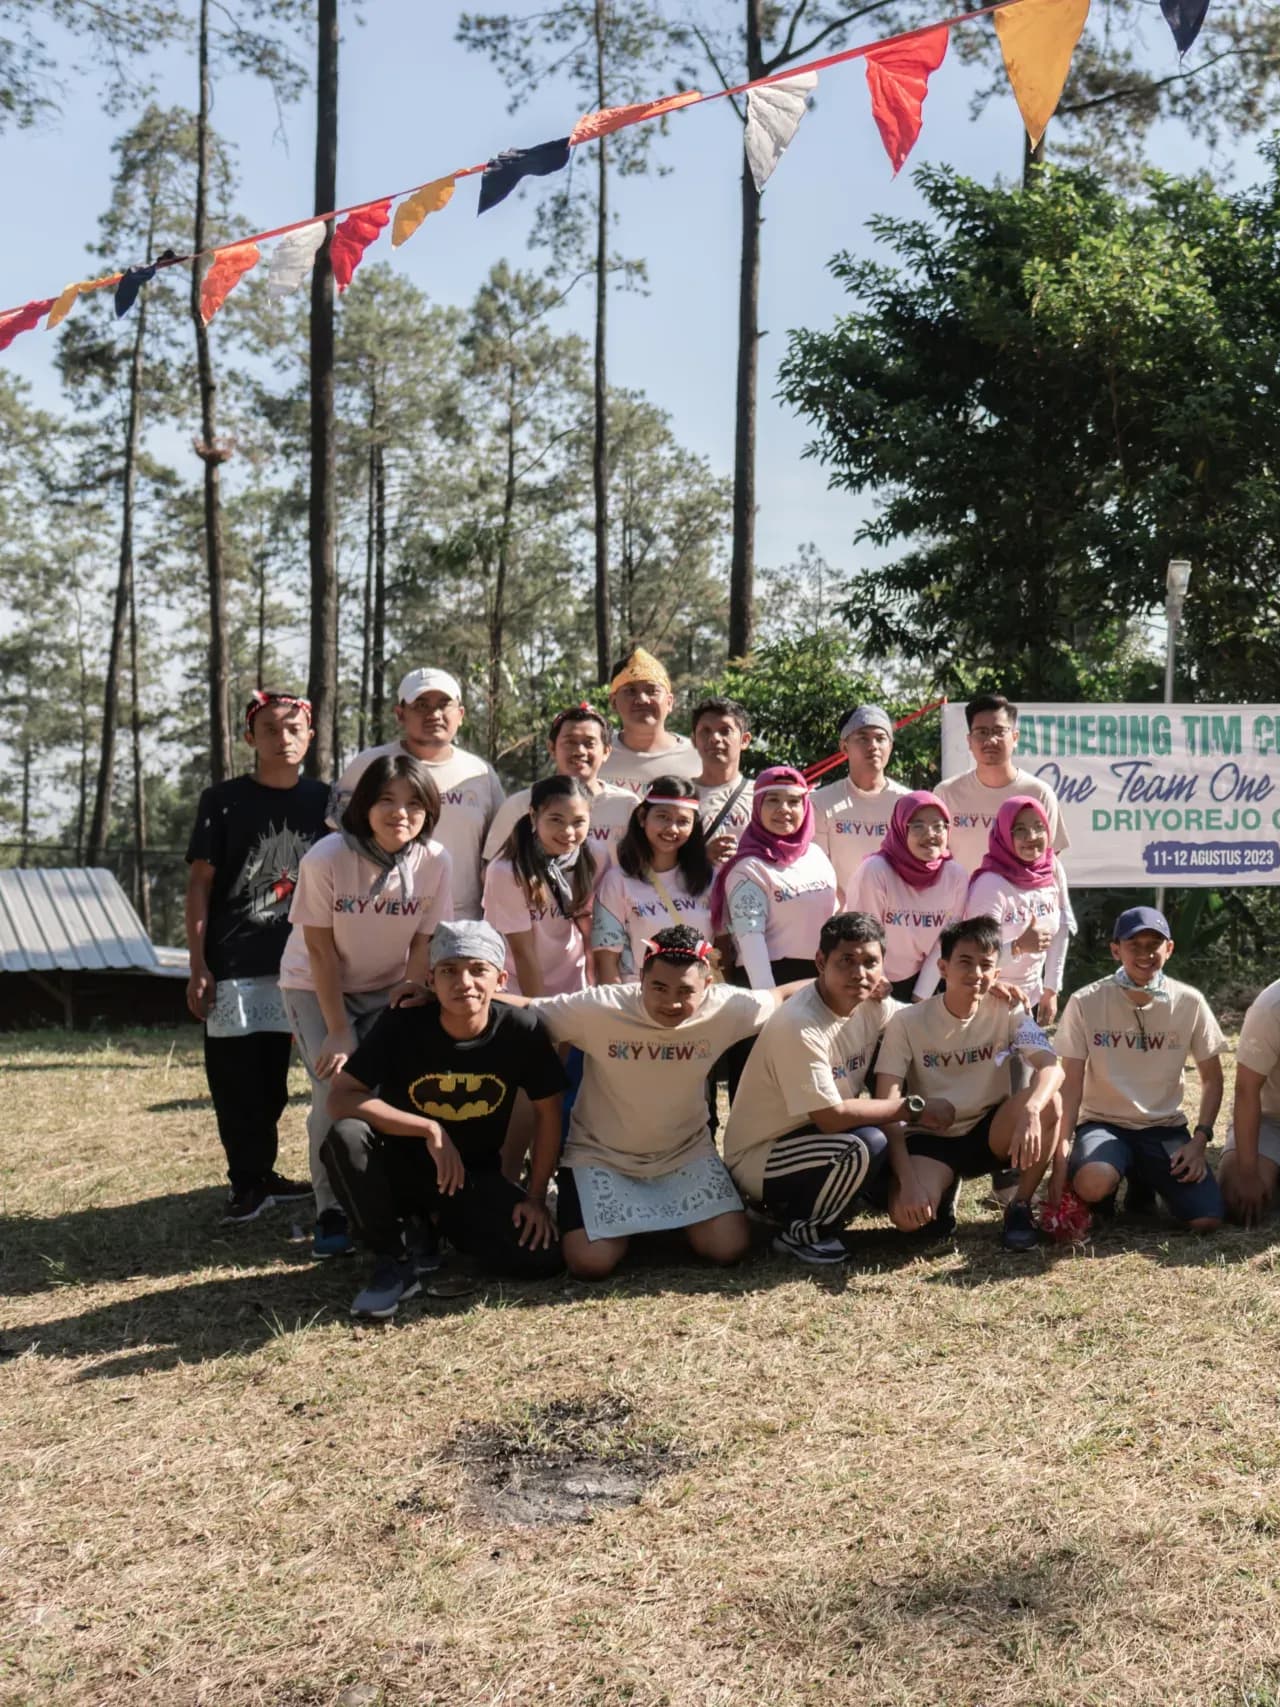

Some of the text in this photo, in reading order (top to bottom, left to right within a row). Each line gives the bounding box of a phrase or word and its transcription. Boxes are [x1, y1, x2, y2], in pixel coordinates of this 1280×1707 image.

[1011, 715, 1171, 757] ATHERING
[1181, 715, 1242, 757] TIM
[1034, 762, 1097, 803] One
[1110, 761, 1200, 803] Team
[1210, 762, 1275, 803] One
[953, 816, 977, 828] SKY
[1092, 808, 1262, 831] DRIYOREJO
[835, 822, 861, 835] SKY
[1153, 850, 1274, 866] 11-12 AGUSTUS 2023
[334, 899, 419, 916] SKY VIEW
[886, 911, 911, 926] SKY
[912, 914, 946, 928] VIEW
[1092, 1033, 1165, 1051] SKY VIEW
[608, 1044, 694, 1061] SKY VIEW
[923, 1054, 952, 1068] SKY
[954, 1046, 993, 1066] VIEW
